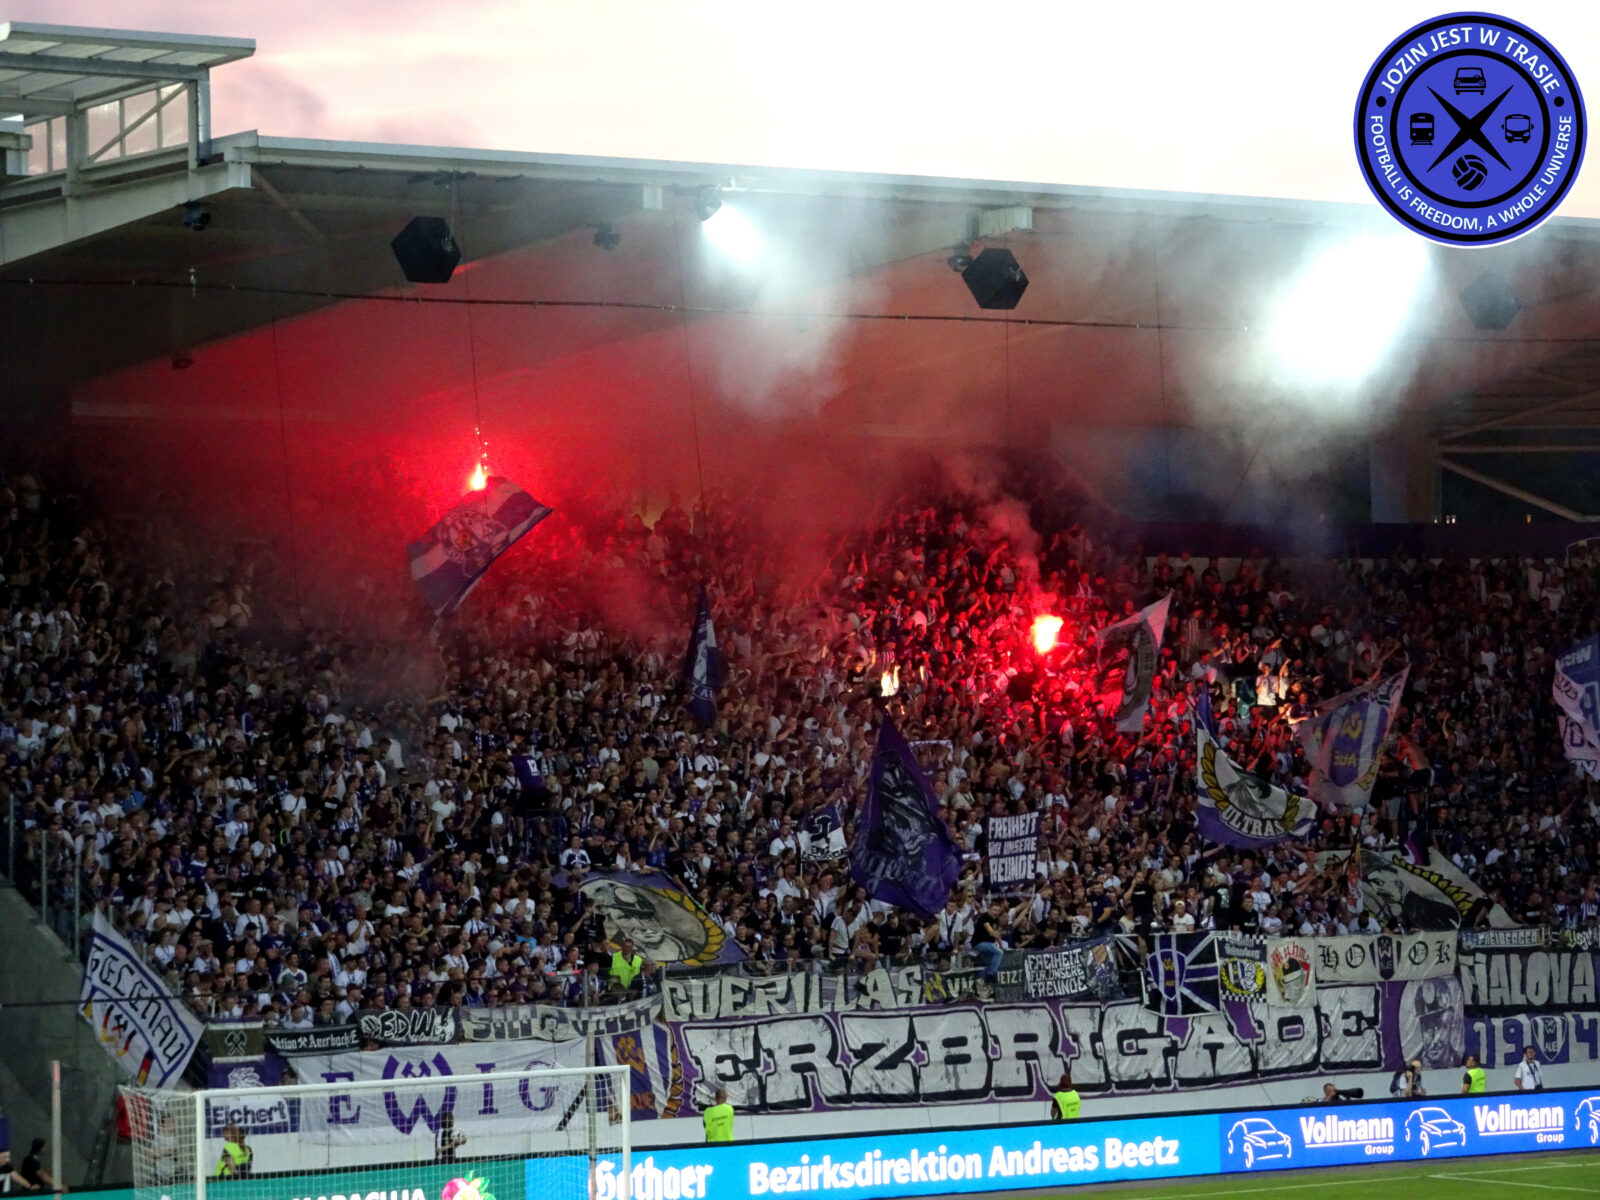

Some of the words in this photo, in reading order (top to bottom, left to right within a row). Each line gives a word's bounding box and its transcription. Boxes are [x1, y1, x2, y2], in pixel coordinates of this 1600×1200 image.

[988, 811, 1039, 840] FREIHEIT
[1221, 805, 1285, 837] ULTRAS
[1027, 948, 1082, 970] FREIHEIT
[662, 965, 923, 1022] GUERILLAS
[1031, 976, 1087, 999] FREUNDE
[684, 984, 1383, 1112] ERZBRIGADE
[321, 1052, 559, 1135] EWIG
[212, 1100, 287, 1125] Eichert
[1473, 1103, 1564, 1132] Vollmann
[1299, 1114, 1394, 1144] Vollmann
[1536, 1133, 1564, 1144] Group
[1364, 1144, 1395, 1155] Group
[749, 1144, 982, 1195] Bezirksdirektion
[987, 1140, 1099, 1177] Andreas
[1104, 1135, 1180, 1169] Beetz
